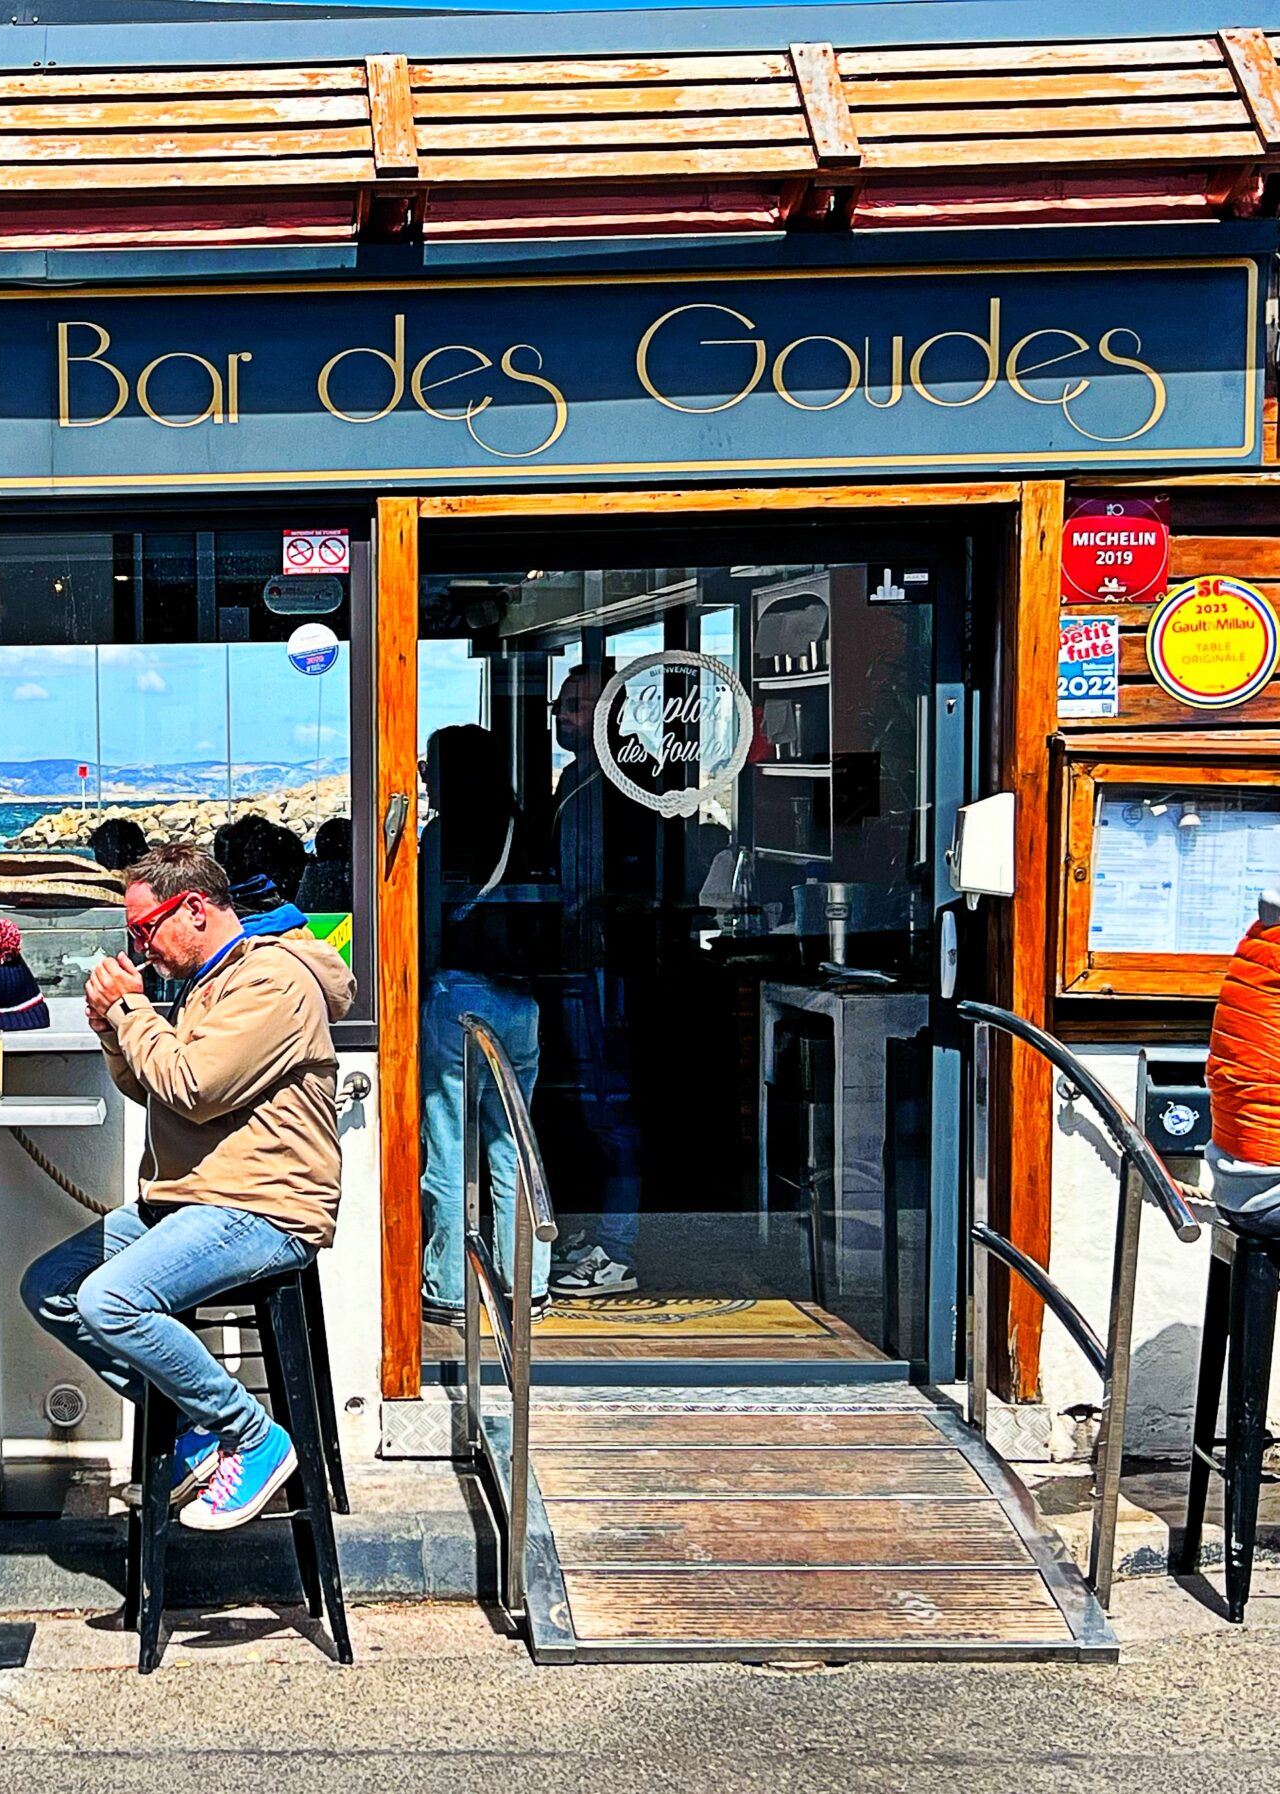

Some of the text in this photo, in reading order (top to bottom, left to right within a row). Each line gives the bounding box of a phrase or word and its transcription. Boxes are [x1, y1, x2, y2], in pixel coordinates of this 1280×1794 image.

[57, 321, 253, 428] Bar
[317, 314, 568, 458] des
[636, 297, 1168, 443] Goudes
[1072, 531, 1157, 547] MICHELIN
[1095, 550, 1134, 566] 2019
[1195, 602, 1229, 615] 2023
[1067, 639, 1114, 662] futé
[1196, 641, 1232, 653] TABLE
[1181, 652, 1246, 665] ORIGINALE
[649, 665, 699, 678] BIENVENUE
[1057, 676, 1116, 697] 2022
[616, 737, 648, 763] des
